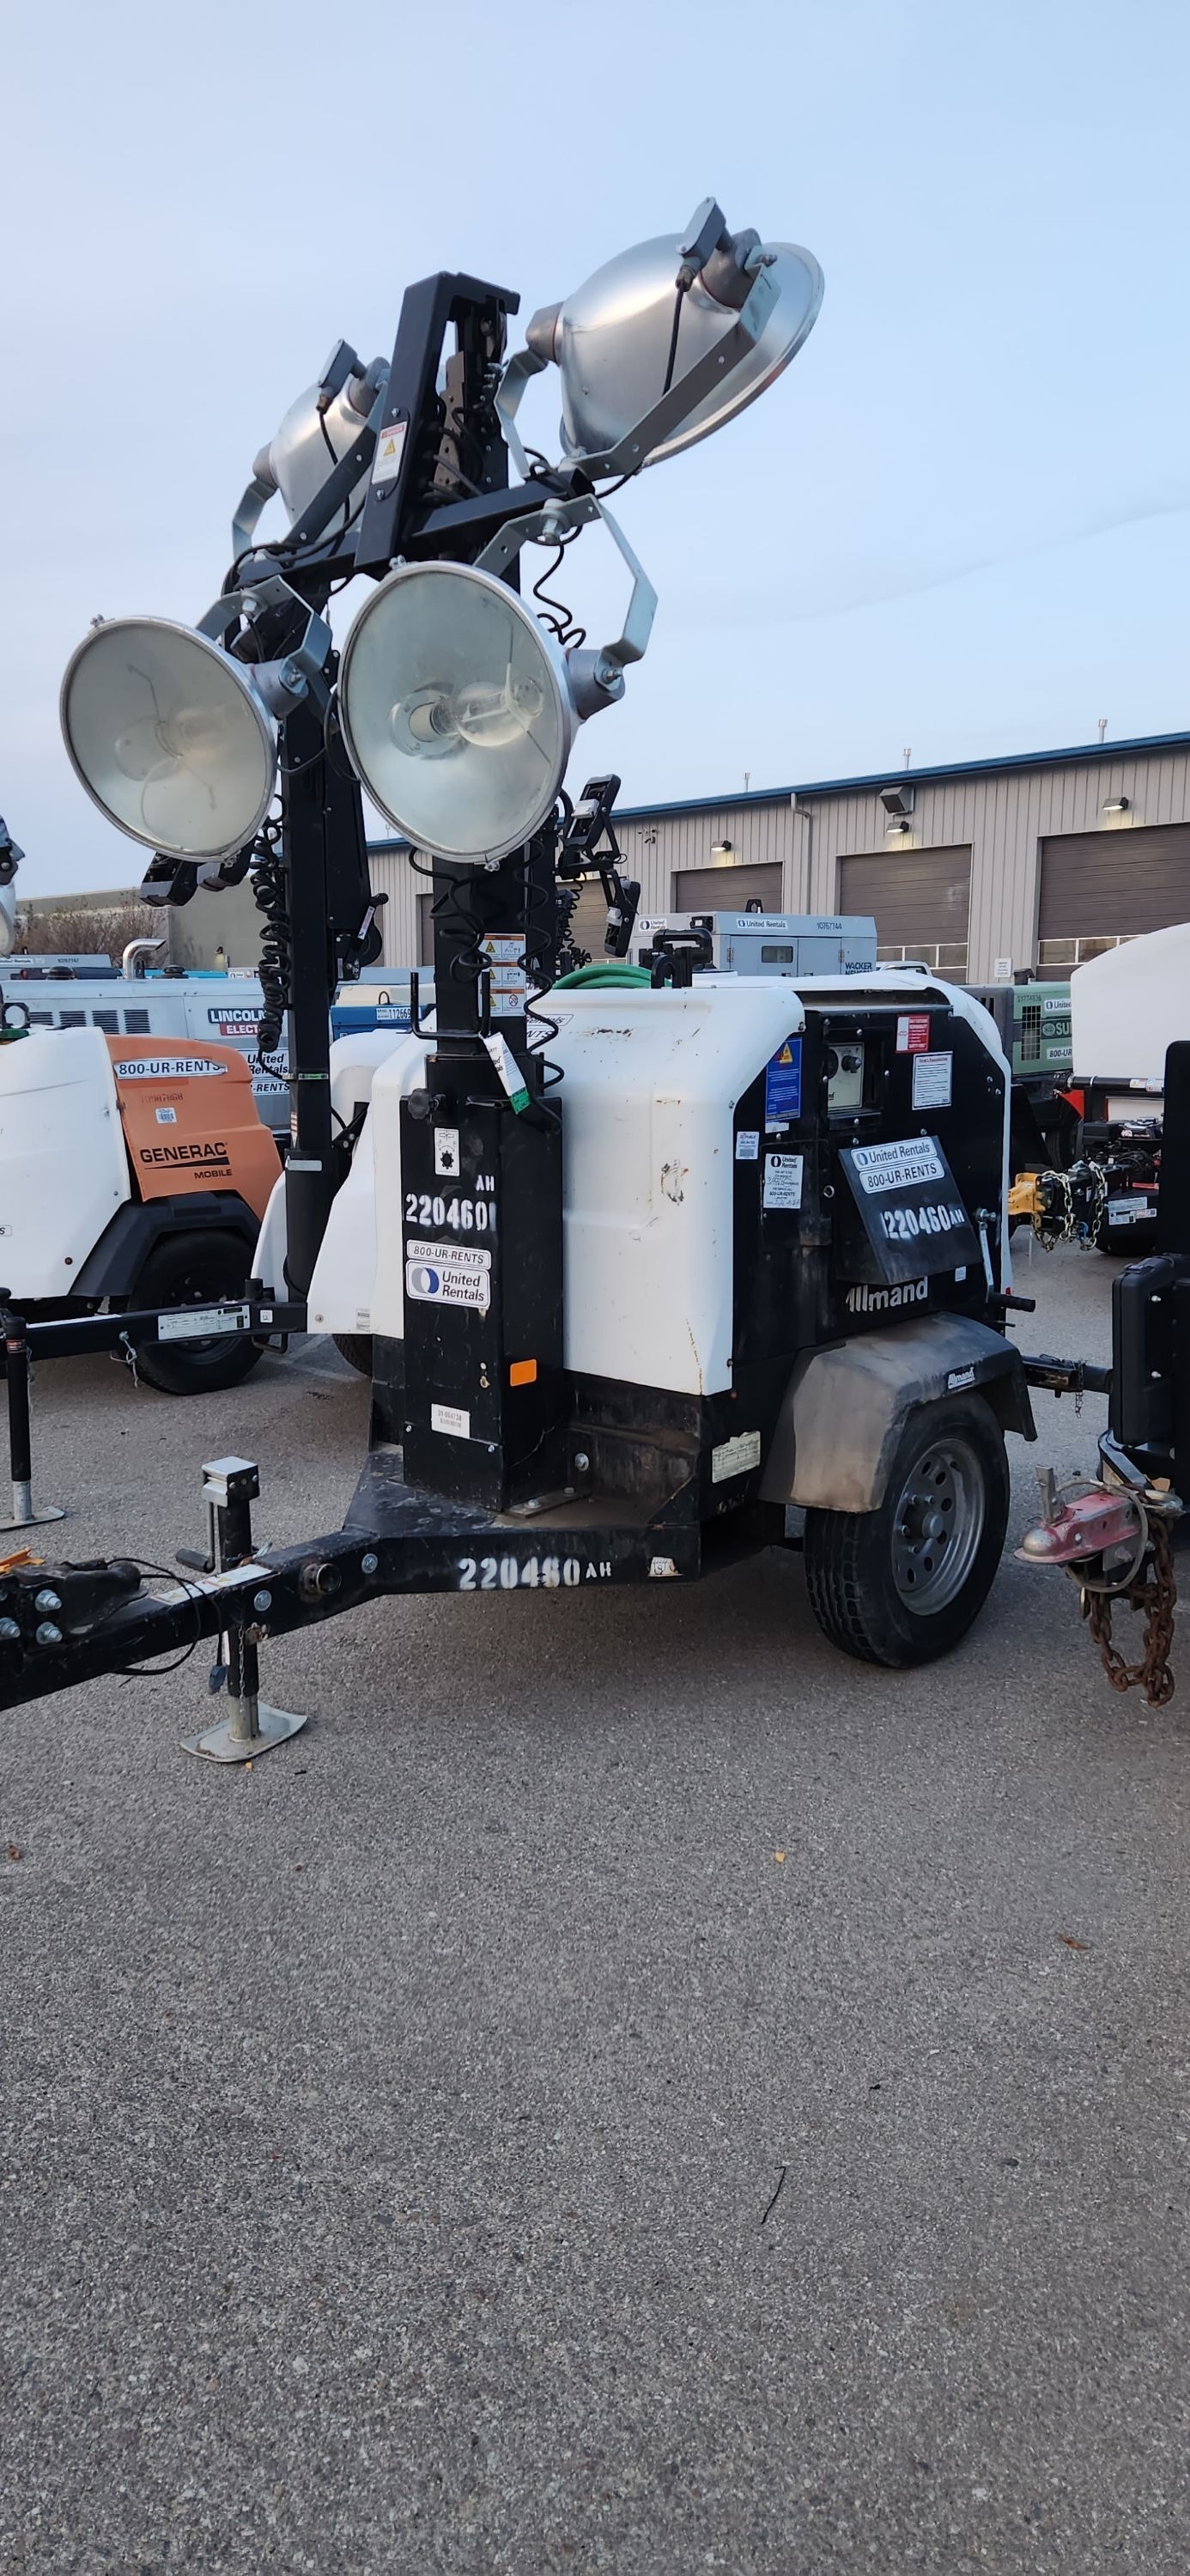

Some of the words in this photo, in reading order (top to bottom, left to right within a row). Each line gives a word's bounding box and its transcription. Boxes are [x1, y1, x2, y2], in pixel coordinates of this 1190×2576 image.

[845, 961, 872, 969] WACKER
[389, 1008, 412, 1019] 112669
[227, 1024, 261, 1035] ELECT
[119, 1060, 222, 1075] 800-UR-RENTS
[251, 1083, 289, 1092] -RENTS
[140, 1142, 228, 1163] GENERAC
[868, 1149, 898, 1164] United
[899, 1144, 930, 1158] Rentals
[194, 1169, 233, 1179] MOBILE
[867, 1163, 938, 1188] 800-UR-RENTS
[476, 1175, 495, 1191] AH
[405, 1194, 488, 1230] 220460
[883, 1205, 952, 1239] 220460
[950, 1208, 965, 1225] AH
[414, 1245, 484, 1264] 800-UR-RENTS
[442, 1271, 481, 1286] United
[442, 1285, 485, 1302] Rentals
[586, 1562, 612, 1578] AH
